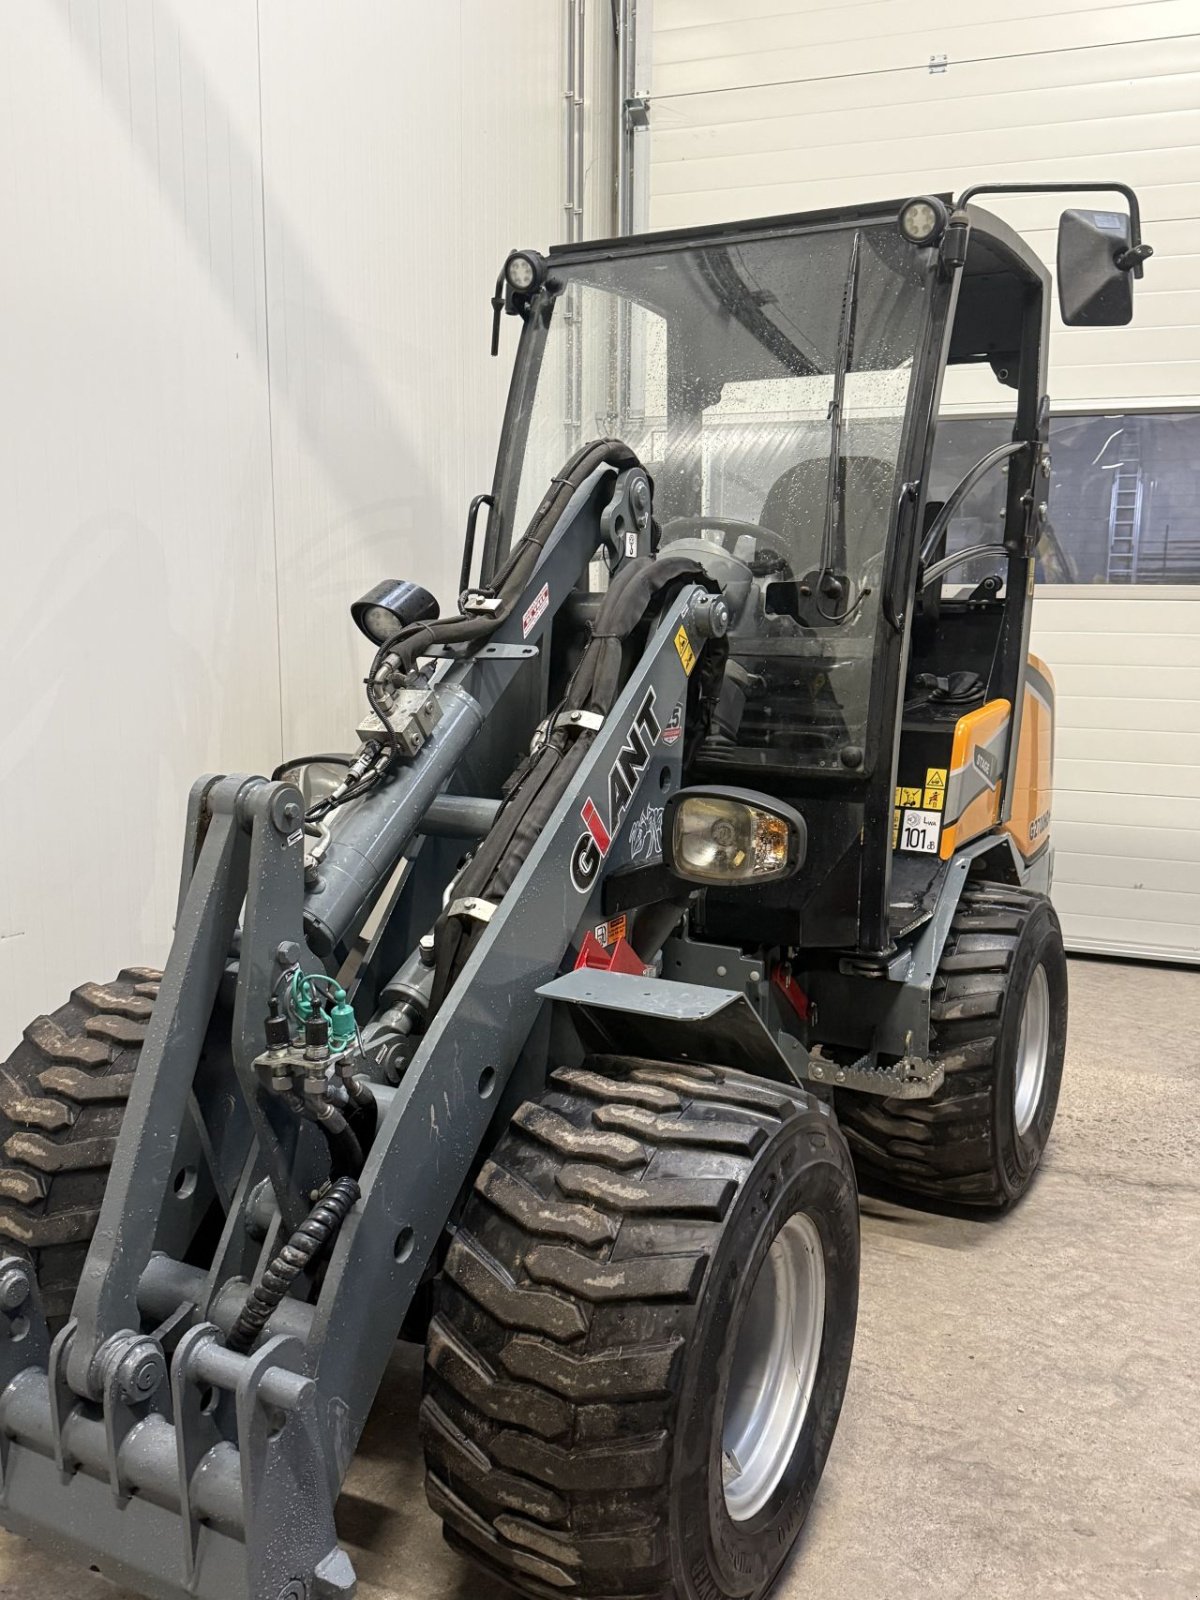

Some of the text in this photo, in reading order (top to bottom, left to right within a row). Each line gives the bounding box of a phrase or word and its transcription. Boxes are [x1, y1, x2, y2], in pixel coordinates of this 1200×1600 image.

[976, 754, 991, 775] STAGE
[569, 684, 662, 894] GIANT
[904, 827, 936, 850] 101 dB
